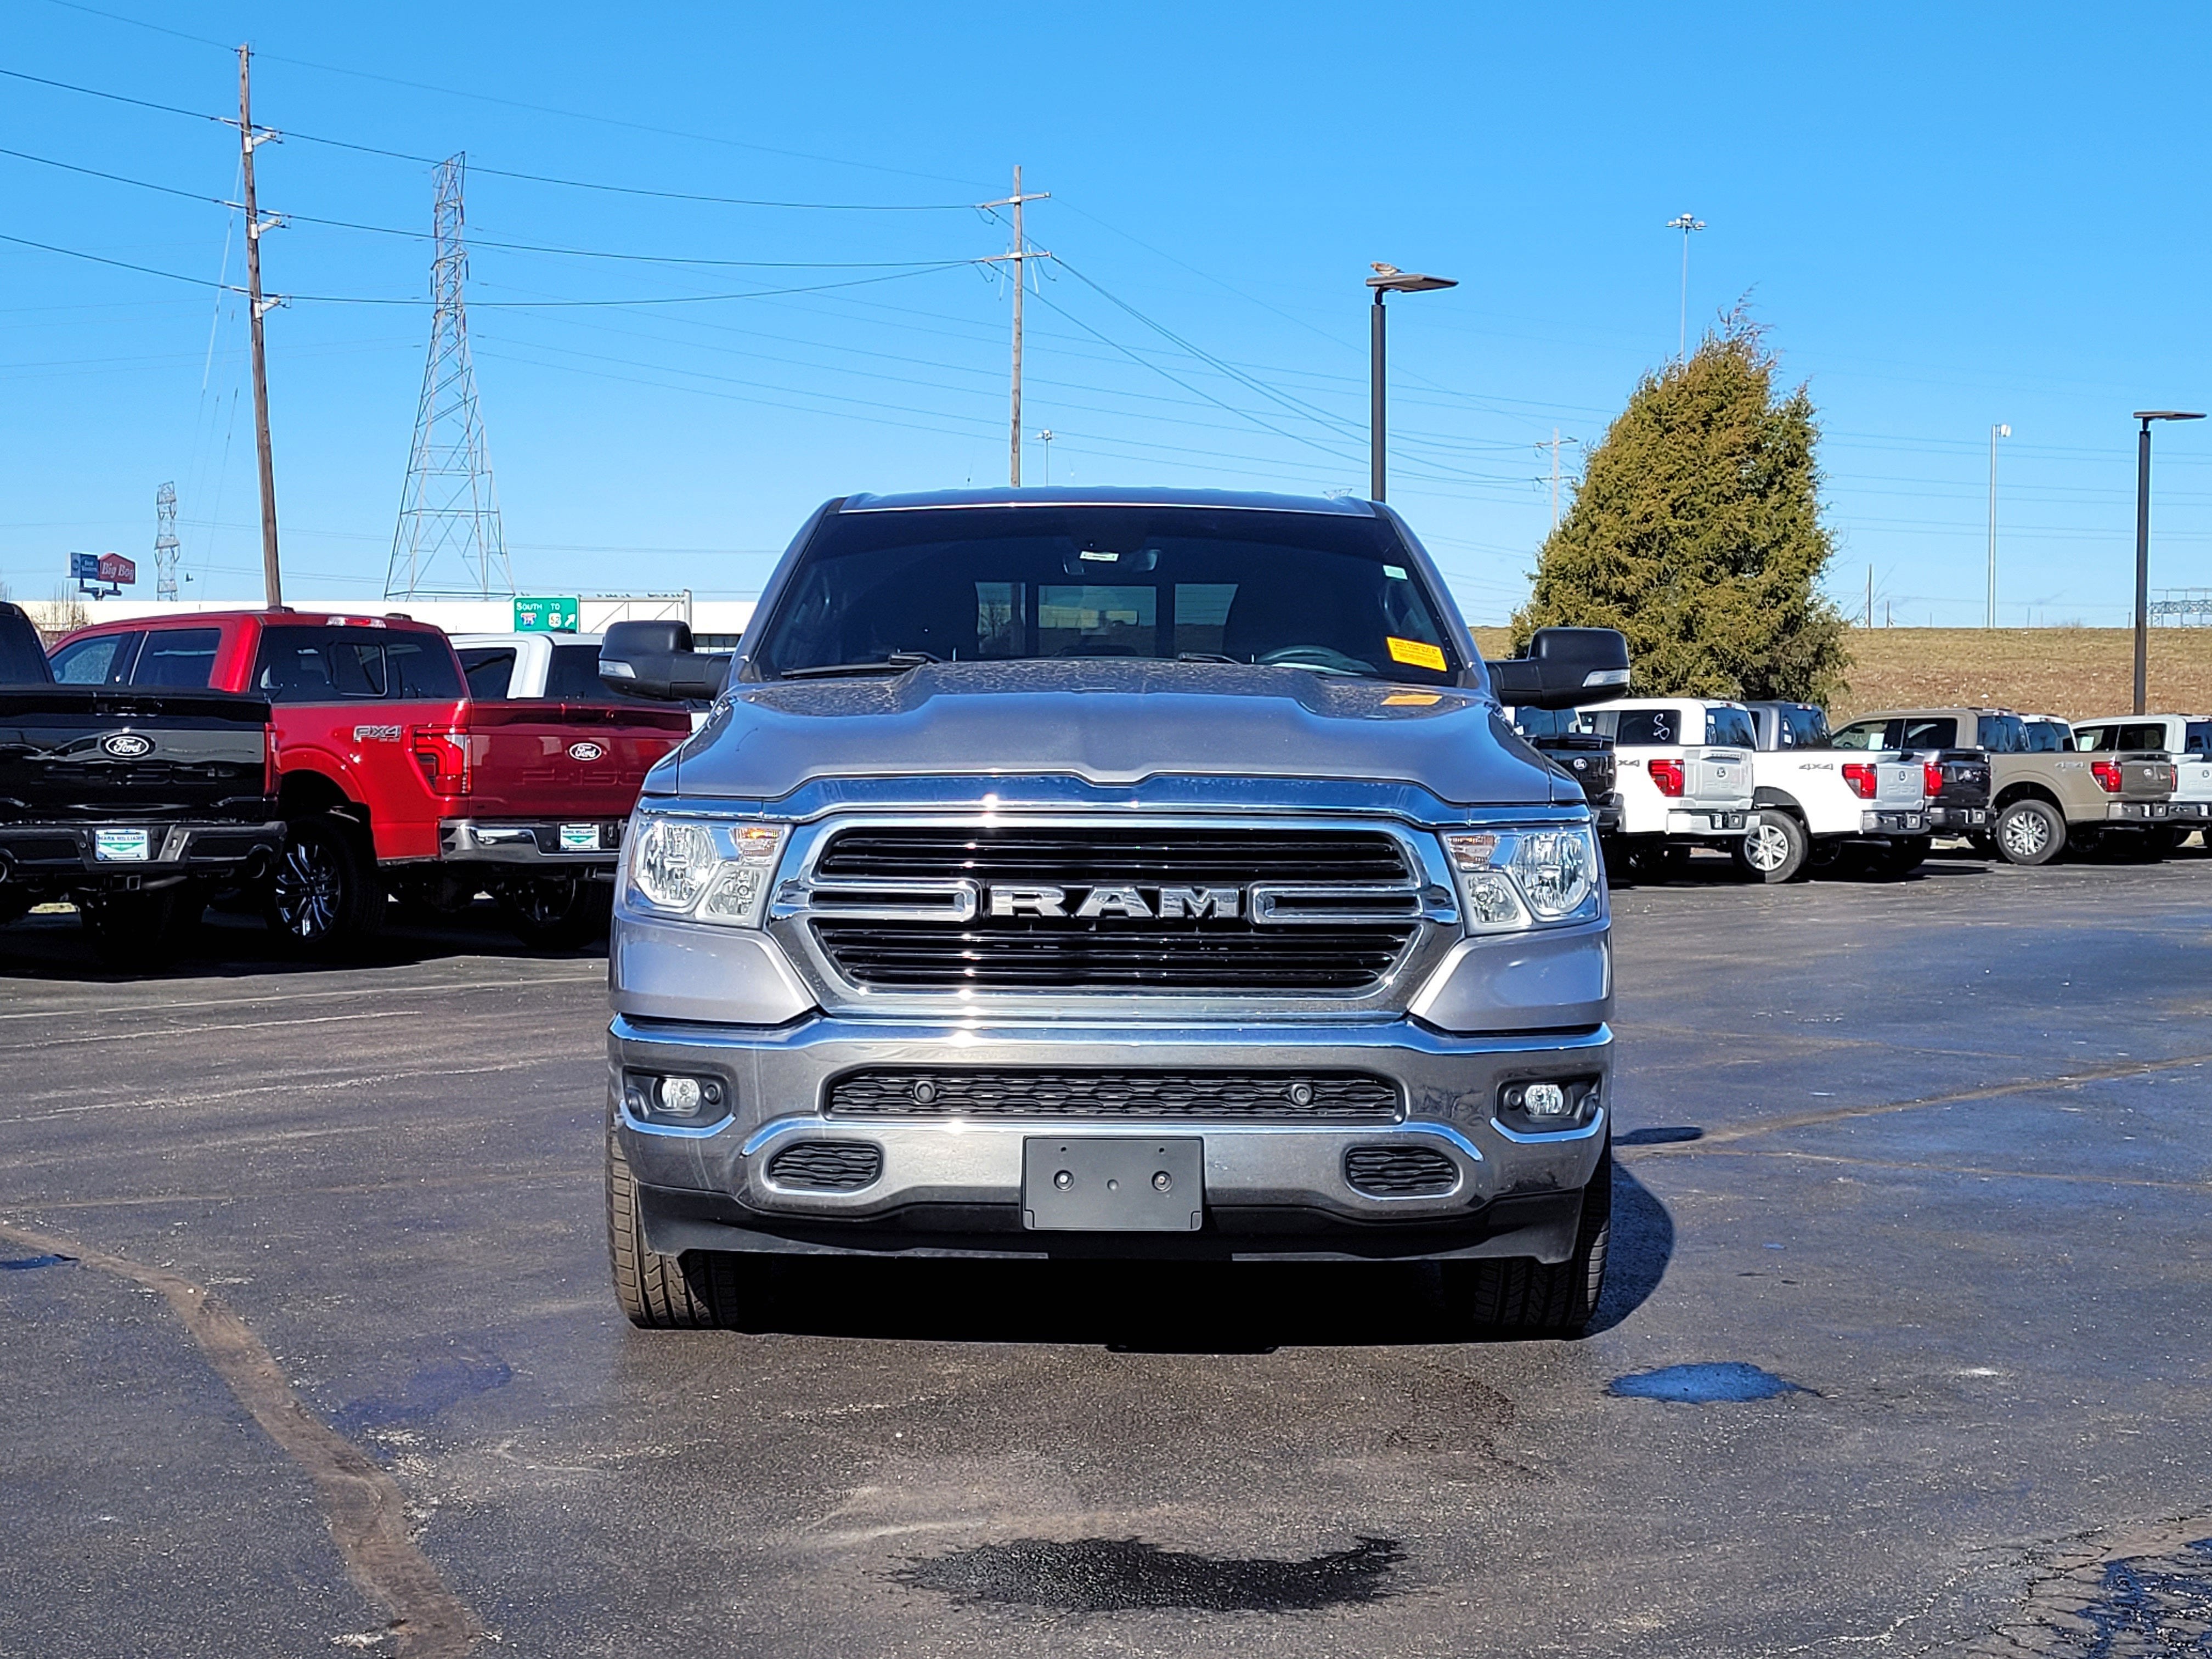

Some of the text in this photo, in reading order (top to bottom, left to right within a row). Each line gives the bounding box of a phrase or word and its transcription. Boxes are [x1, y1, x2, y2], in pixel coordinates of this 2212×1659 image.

[101, 562, 116, 578] Big
[118, 564, 134, 580] Boy
[516, 602, 543, 611] SOUTH
[353, 725, 402, 742] FX4
[114, 738, 142, 752] Ford
[989, 885, 1240, 917] RAM
